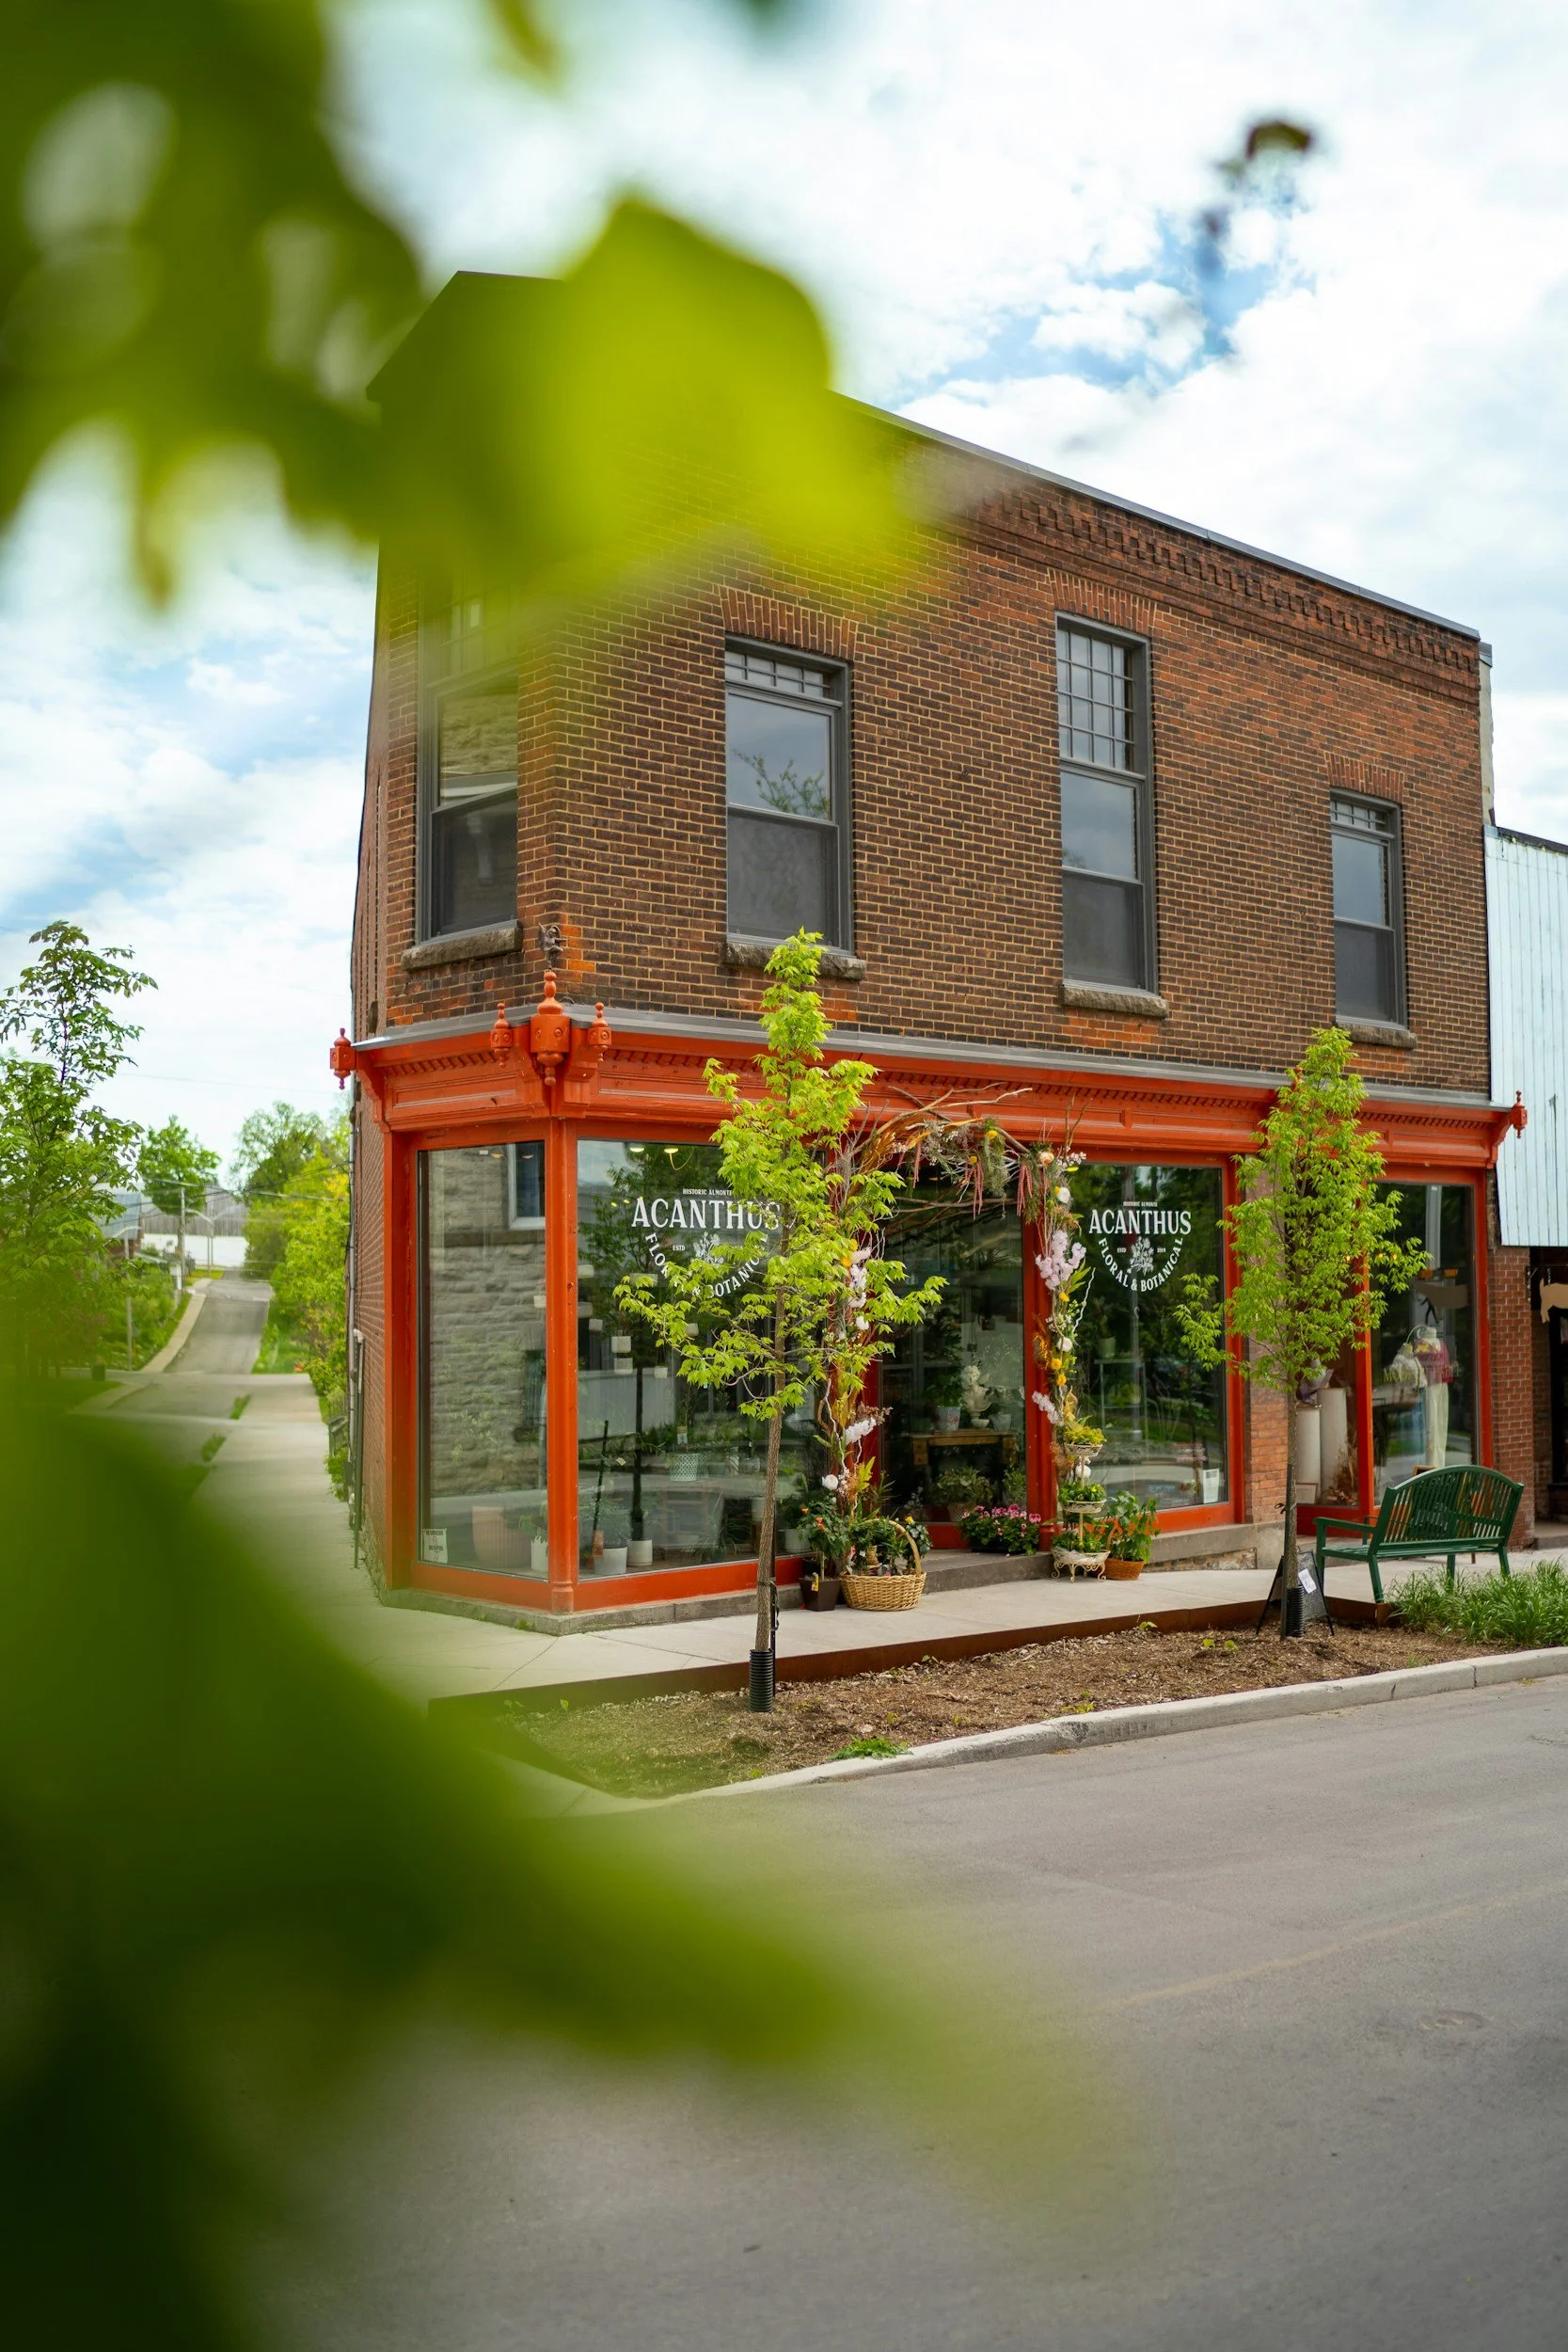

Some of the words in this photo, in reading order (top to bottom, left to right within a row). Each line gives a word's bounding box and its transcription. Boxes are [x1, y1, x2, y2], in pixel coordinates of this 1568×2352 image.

[631, 1198, 781, 1231] ACANTHUS
[1088, 1209, 1192, 1235] ACANTHUS
[1098, 1237, 1129, 1288] FLORAL
[1131, 1278, 1138, 1292] &
[1140, 1237, 1183, 1293] BOTANICAL
